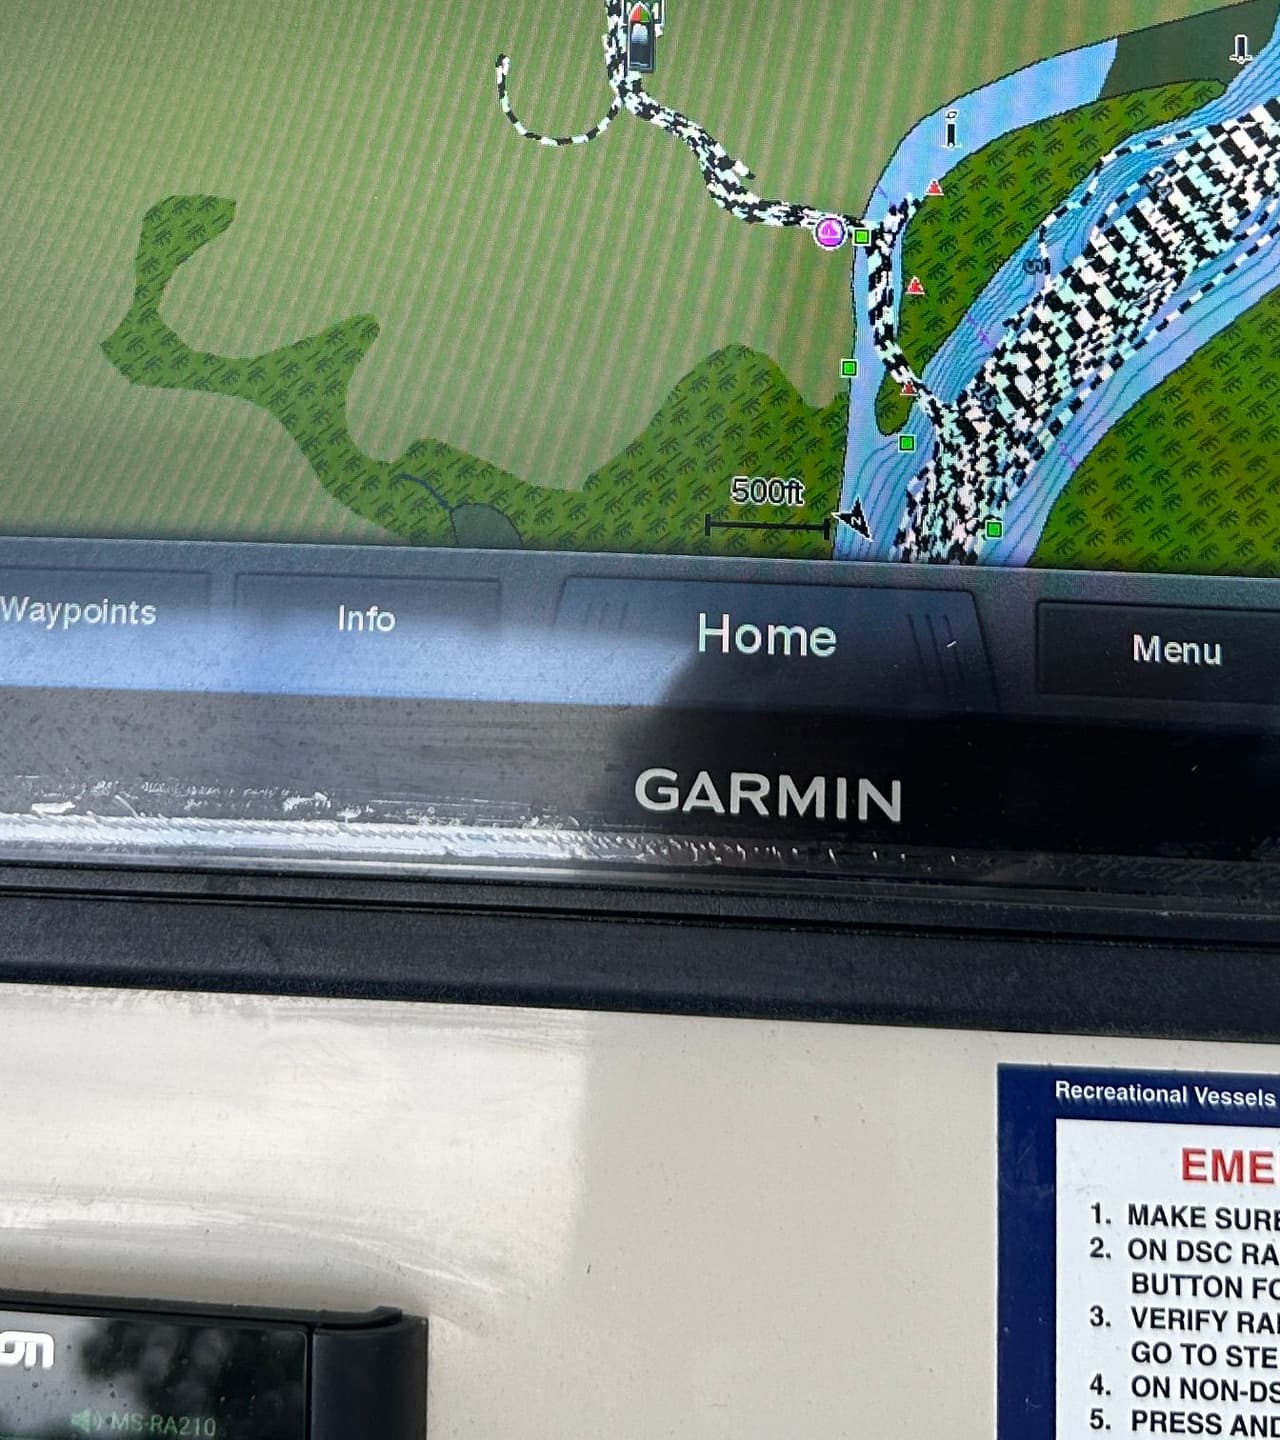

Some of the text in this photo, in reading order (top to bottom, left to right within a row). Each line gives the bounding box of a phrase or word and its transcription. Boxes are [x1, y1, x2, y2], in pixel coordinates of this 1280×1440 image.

[731, 476, 805, 506] 500ft
[0, 593, 158, 631] Waypoints
[337, 604, 397, 633] Info
[698, 611, 838, 659] Home
[1133, 633, 1223, 667] Menu
[634, 766, 903, 824] GARMIN
[1056, 1080, 1276, 1108] Recreational Vessels
[1090, 1202, 1112, 1226] 1.
[1128, 1203, 1206, 1229] MAKE
[1089, 1237, 1112, 1259] 2.
[1127, 1237, 1167, 1261] ON
[1176, 1240, 1233, 1264] DSC
[1131, 1272, 1243, 1300] BUTTON
[1089, 1305, 1112, 1328] 3.
[1131, 1305, 1229, 1333] VERIFY
[1131, 1341, 1172, 1365] GO
[1180, 1343, 1217, 1367] TO
[1089, 1373, 1112, 1396] 4.
[1131, 1374, 1170, 1399] ON
[1089, 1408, 1112, 1430] 5.
[1131, 1409, 1222, 1436] PRESS
